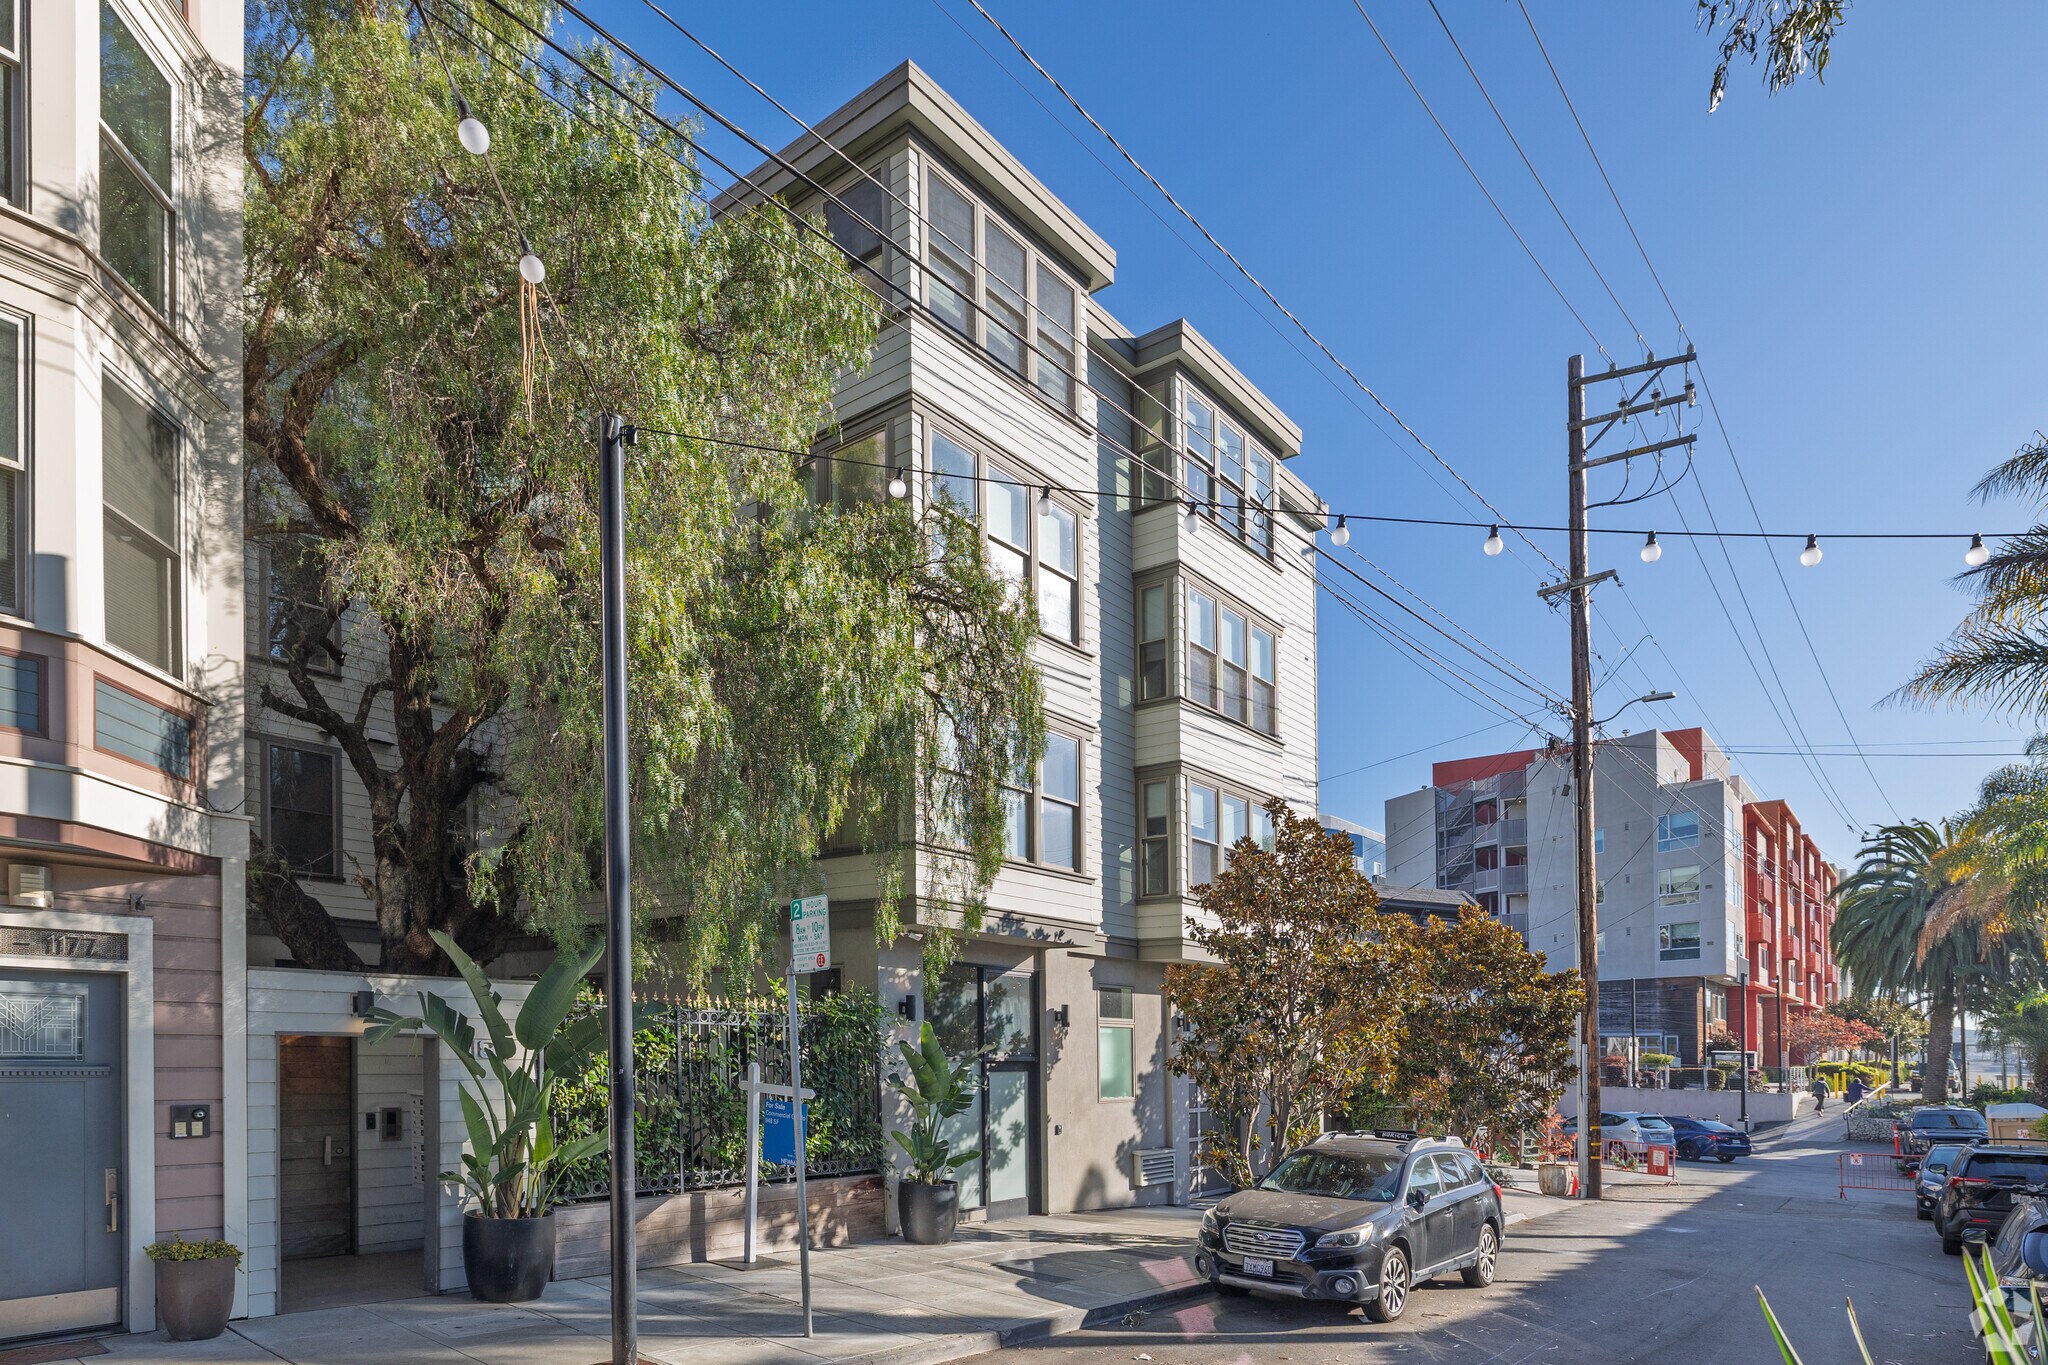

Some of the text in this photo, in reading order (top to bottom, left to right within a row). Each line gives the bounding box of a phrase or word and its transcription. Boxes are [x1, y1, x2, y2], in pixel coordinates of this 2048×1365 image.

[793, 899, 823, 918] 2 HOUR
[803, 908, 827, 918] PARKING
[795, 924, 806, 934] 8AM
[811, 922, 825, 933] 10PM
[814, 932, 823, 941] SAT
[46, 933, 99, 956] 1177
[765, 1109, 791, 1120] Commercial
